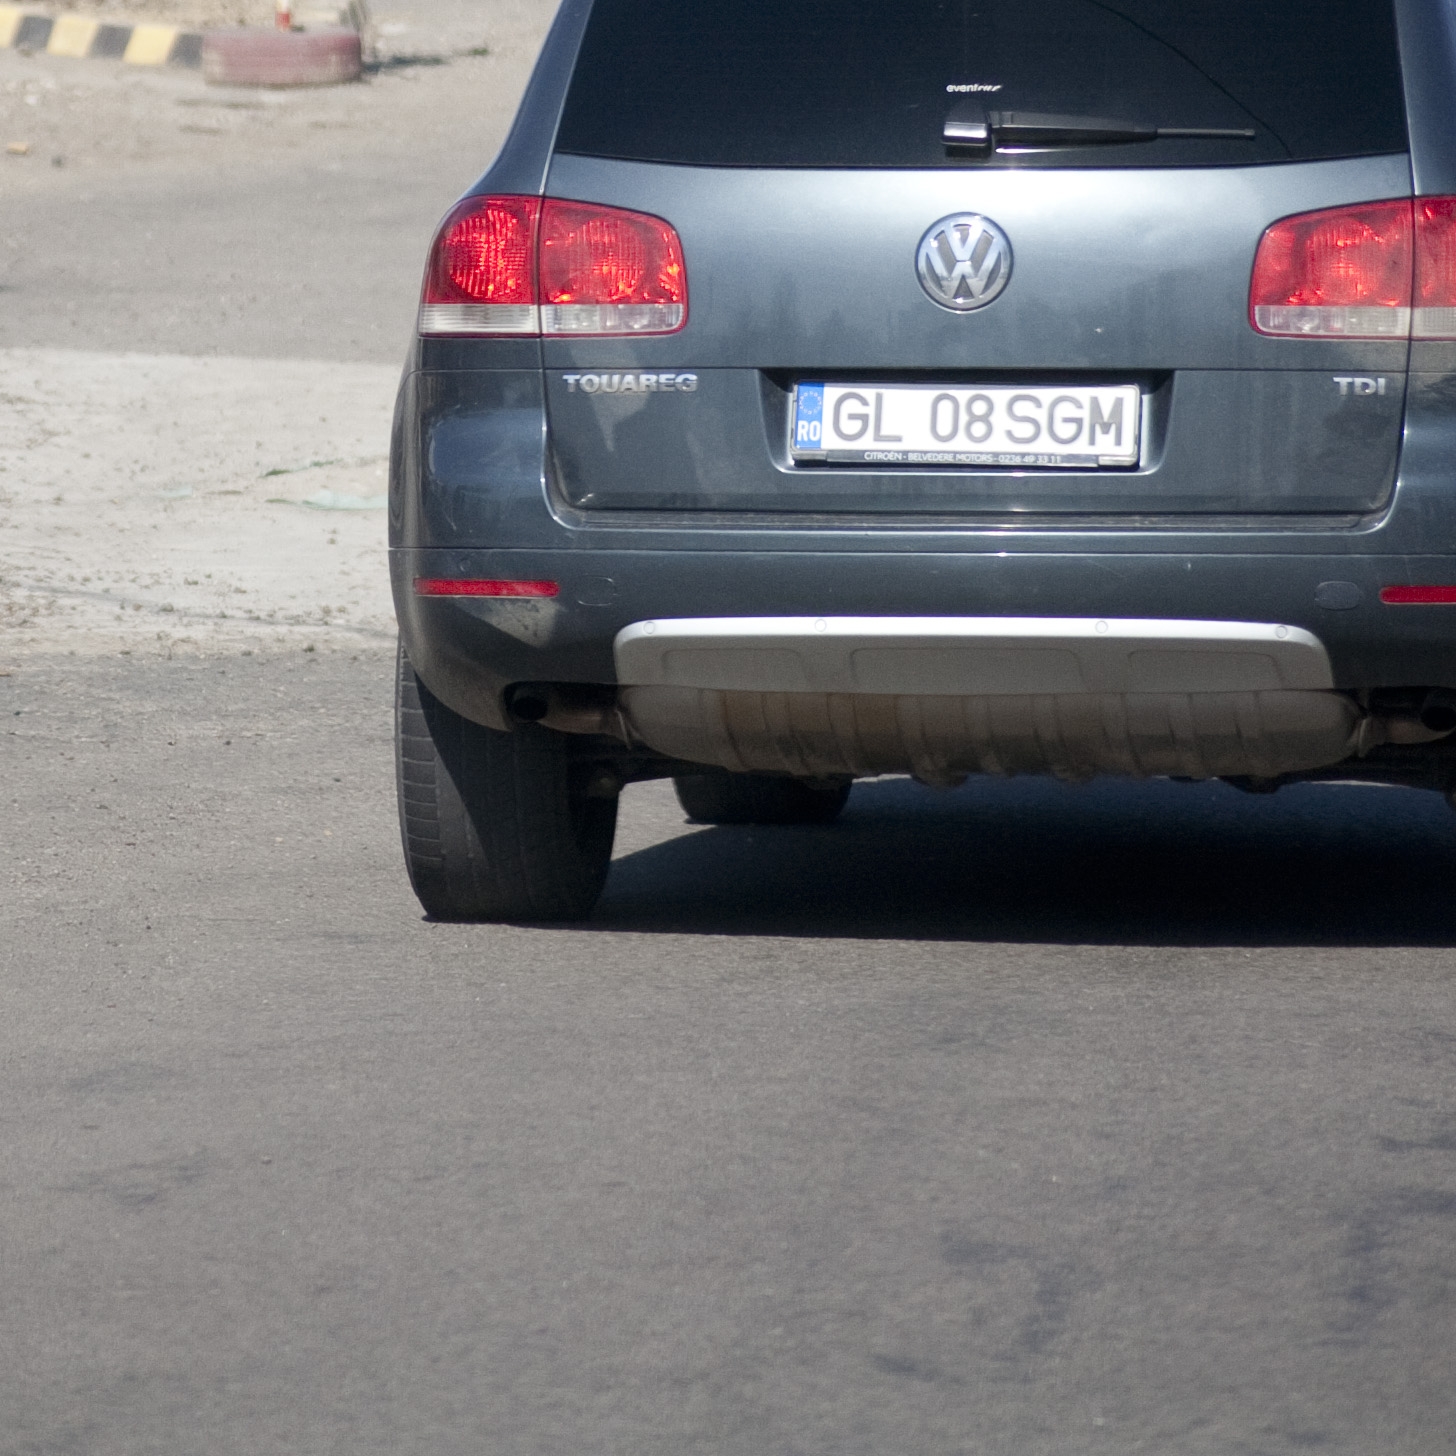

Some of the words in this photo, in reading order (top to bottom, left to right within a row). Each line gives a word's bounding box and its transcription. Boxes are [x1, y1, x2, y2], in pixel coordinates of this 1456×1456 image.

[562, 373, 698, 393] TOUAREG
[1333, 377, 1385, 396] TDI
[832, 391, 903, 442] GL
[797, 420, 821, 442] RO
[907, 452, 954, 462] BELVEDERE
[955, 453, 993, 463] MOTORS
